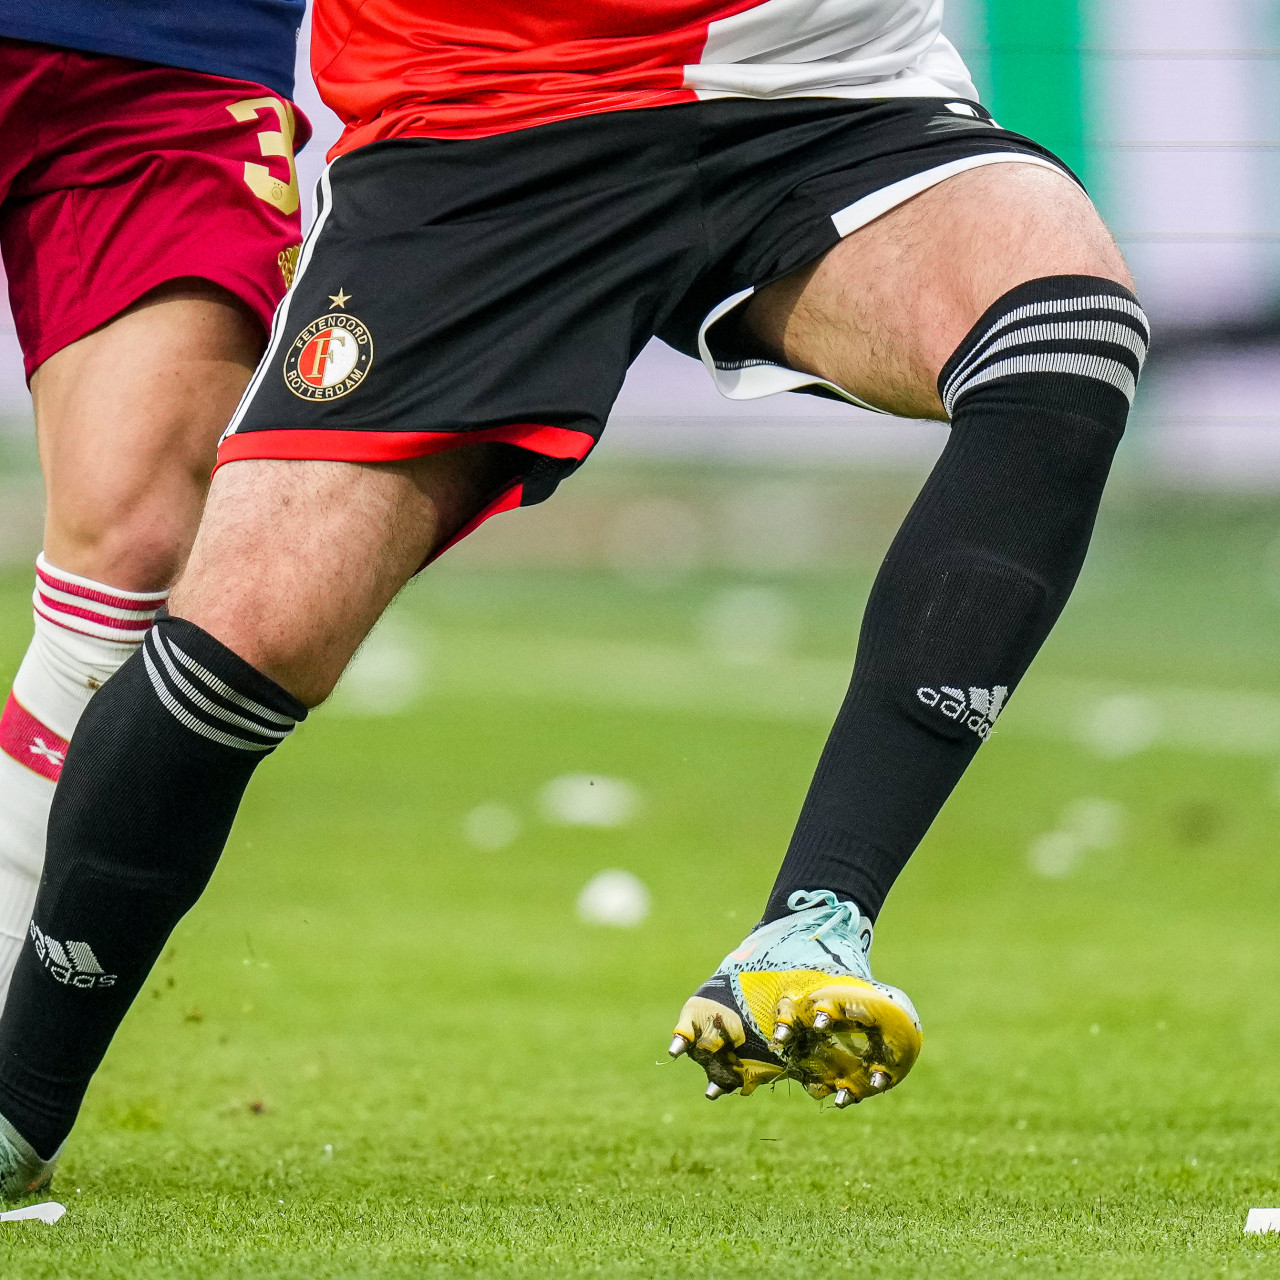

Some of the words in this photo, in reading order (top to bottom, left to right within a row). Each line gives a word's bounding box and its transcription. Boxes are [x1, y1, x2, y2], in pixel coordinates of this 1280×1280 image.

[225, 96, 300, 216] 3
[295, 316, 368, 348] FEYENOORD
[286, 368, 365, 399] ROTTERDAM
[916, 686, 993, 743] adidas
[30, 919, 118, 989] adidas
